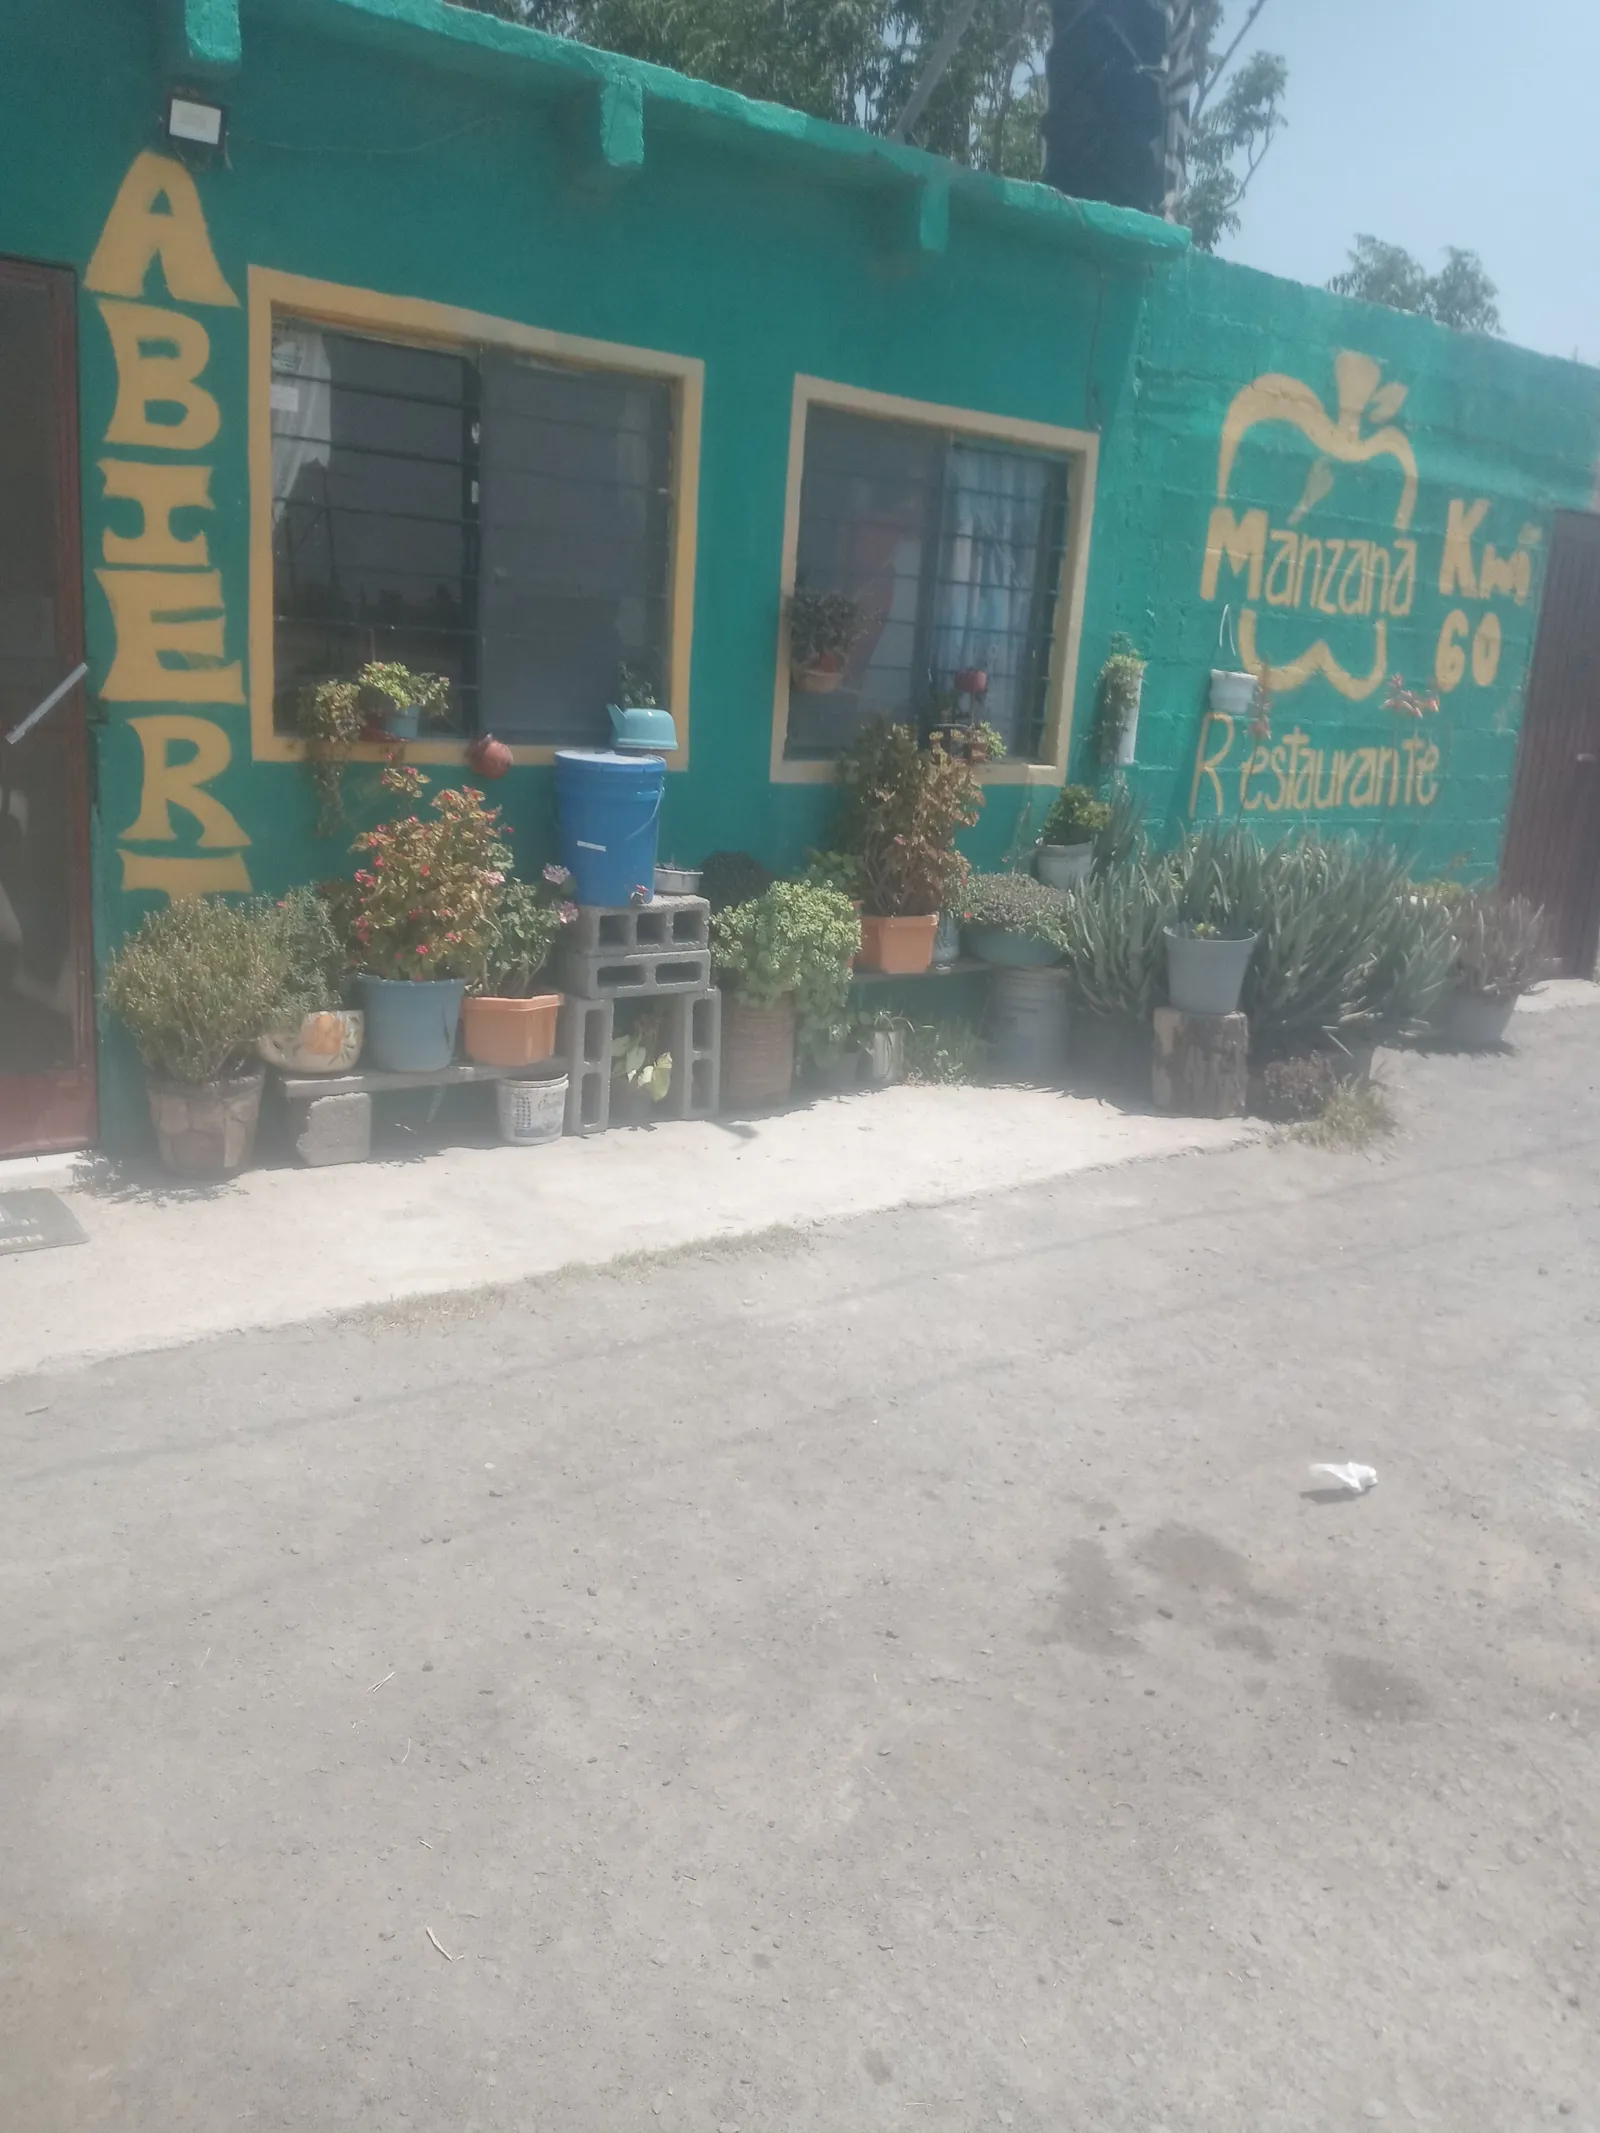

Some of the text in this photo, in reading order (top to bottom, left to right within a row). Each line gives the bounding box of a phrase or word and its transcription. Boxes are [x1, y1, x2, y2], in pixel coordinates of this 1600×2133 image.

[1201, 507, 1416, 616] Manzana
[1435, 609, 1501, 692] 60
[1189, 713, 1439, 818] Restaurante
